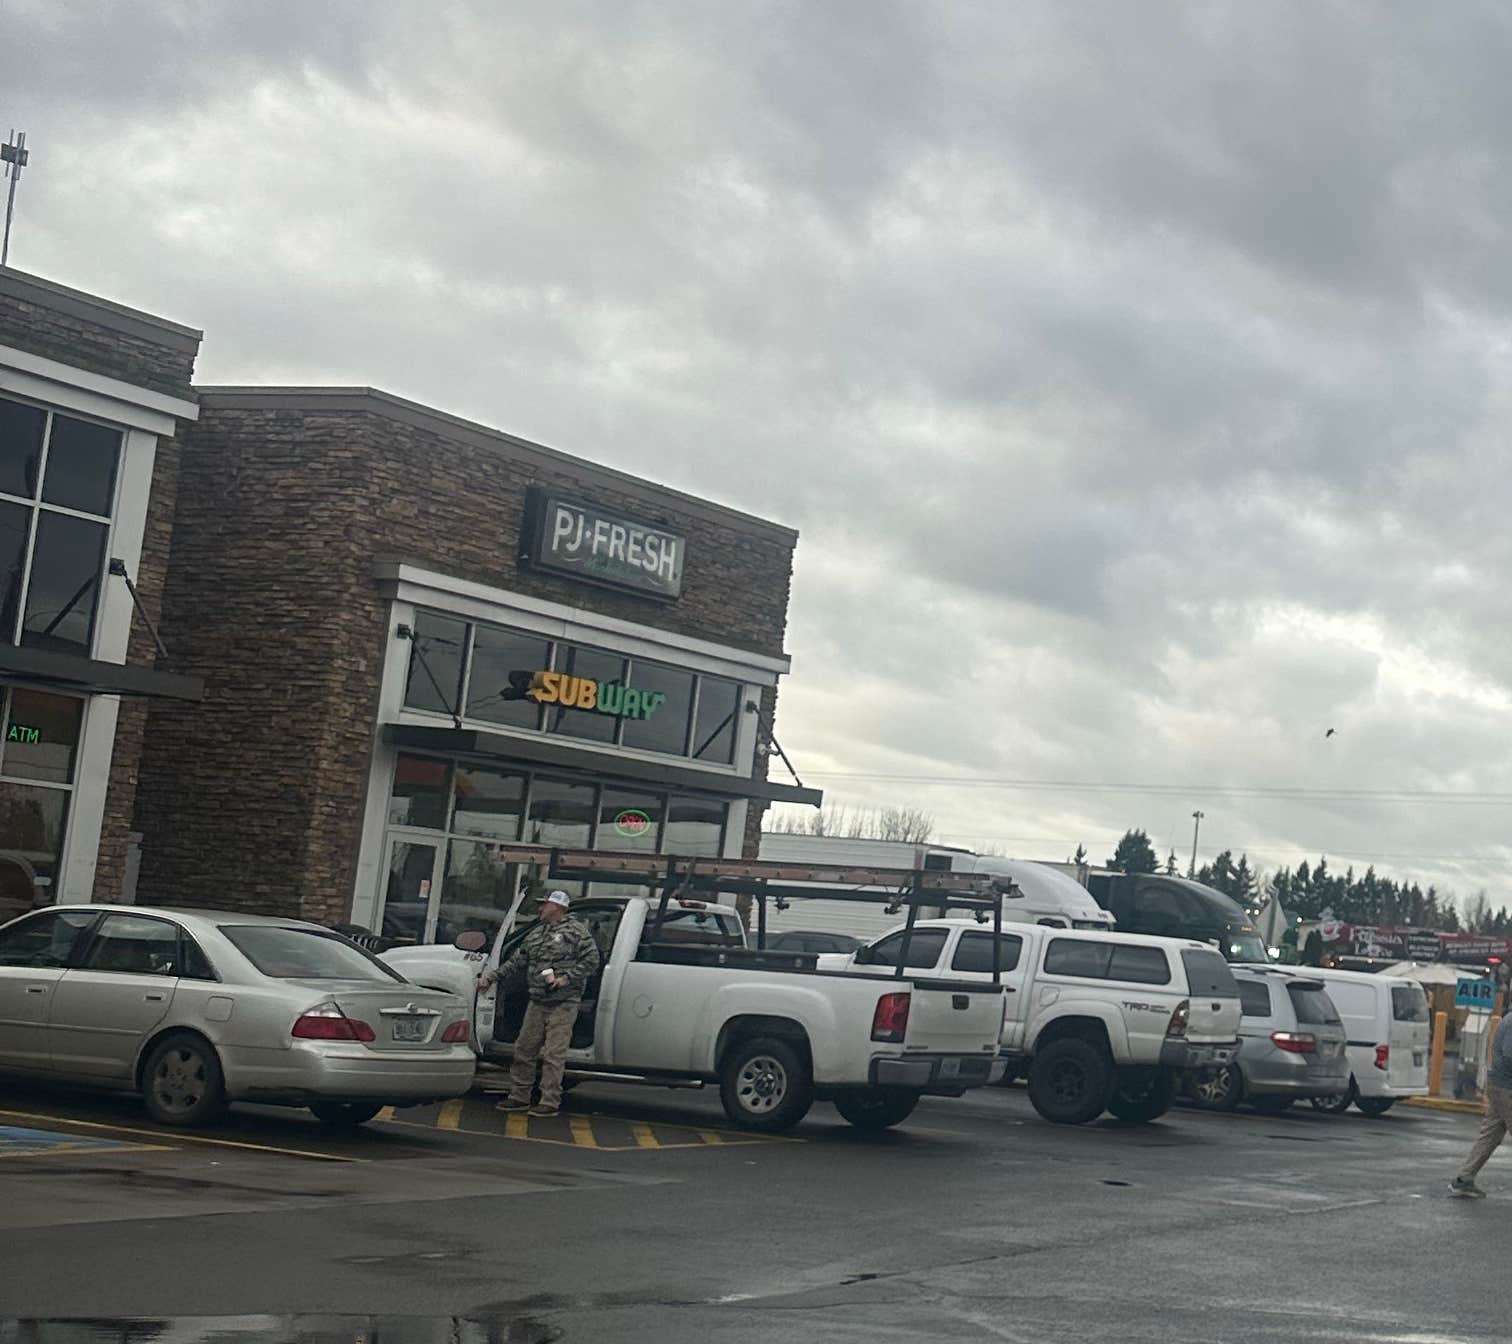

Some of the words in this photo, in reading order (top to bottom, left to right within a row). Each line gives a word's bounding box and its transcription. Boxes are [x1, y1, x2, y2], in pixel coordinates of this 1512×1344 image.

[527, 671, 670, 721] SUBWAY
[8, 725, 40, 745] ATM
[1458, 983, 1493, 999] AIR
